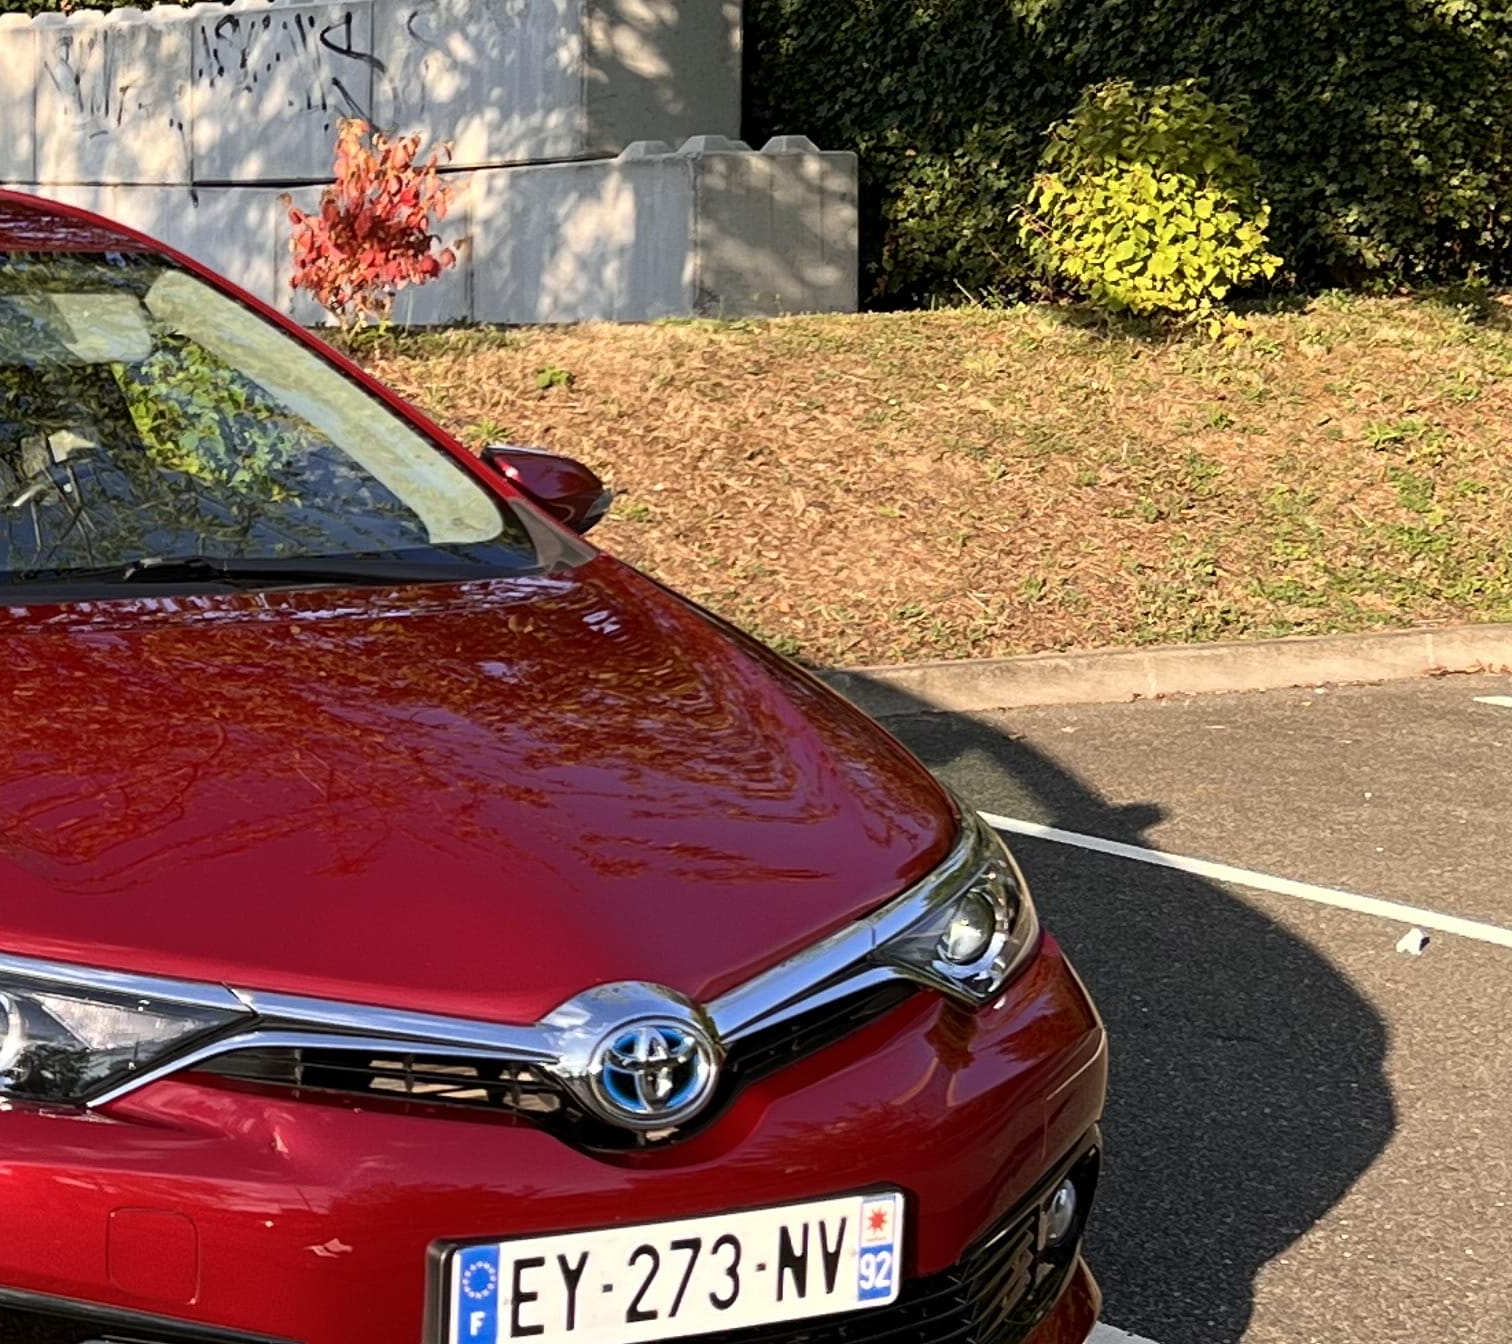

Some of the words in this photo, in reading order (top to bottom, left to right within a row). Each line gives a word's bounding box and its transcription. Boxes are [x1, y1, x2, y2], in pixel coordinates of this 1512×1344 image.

[510, 1217, 847, 1338] EY-273-NV
[860, 1251, 891, 1290] 92
[470, 1311, 486, 1336] F
